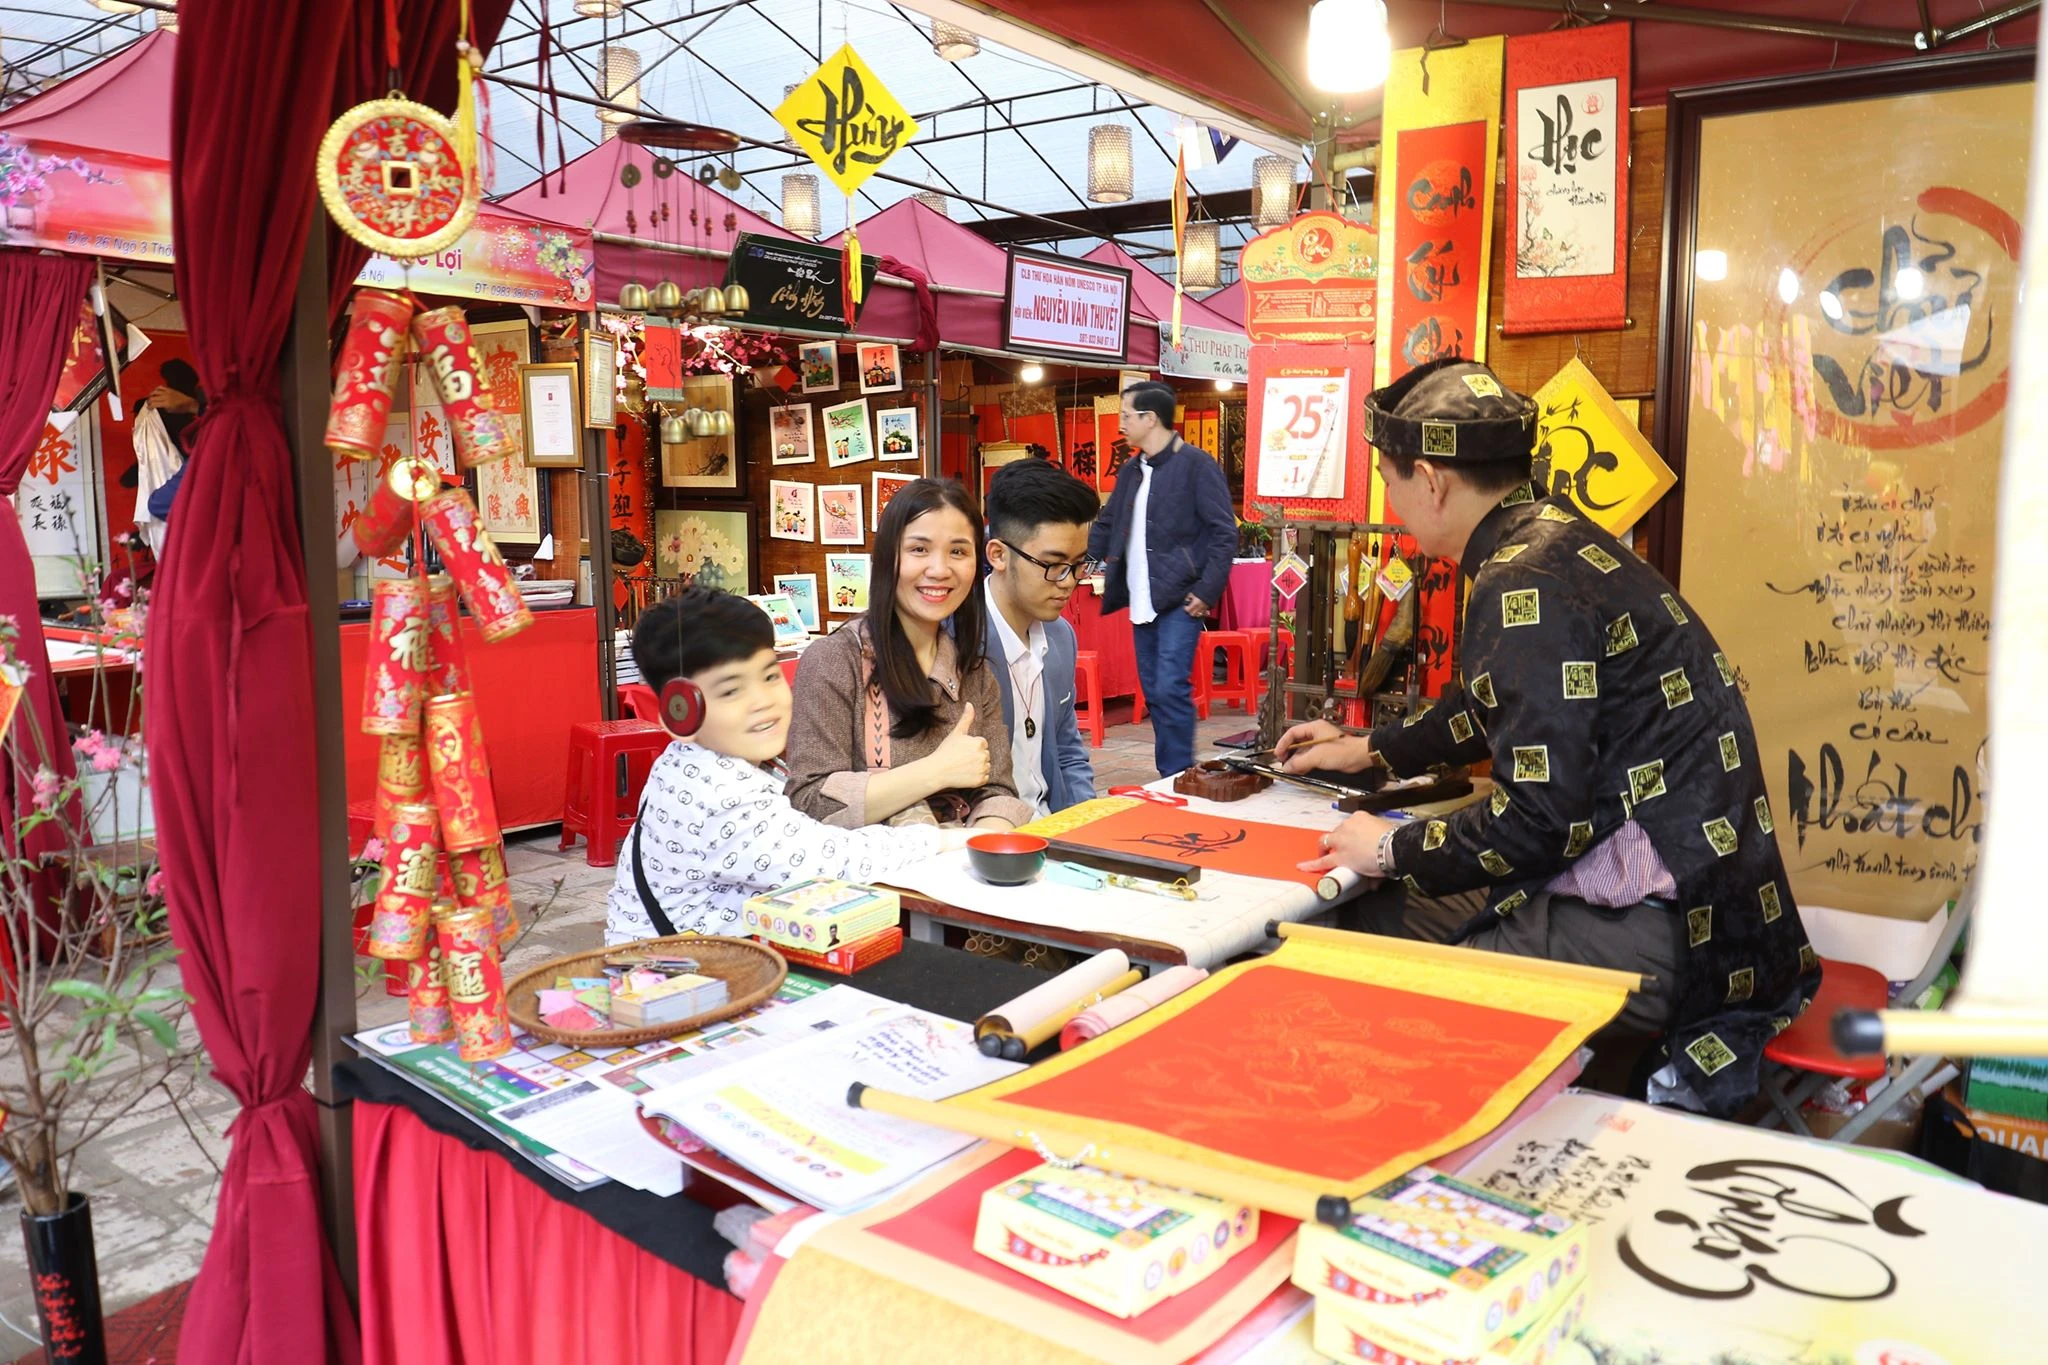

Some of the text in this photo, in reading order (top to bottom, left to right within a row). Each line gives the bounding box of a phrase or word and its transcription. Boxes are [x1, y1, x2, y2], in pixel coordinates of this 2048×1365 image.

[140, 242, 149, 254] 3
[436, 249, 463, 275] Lợi
[1077, 278, 1095, 291] UNESCO
[1071, 297, 1088, 327] VĂN
[1284, 395, 1324, 439] 25
[1291, 466, 1300, 484] 1
